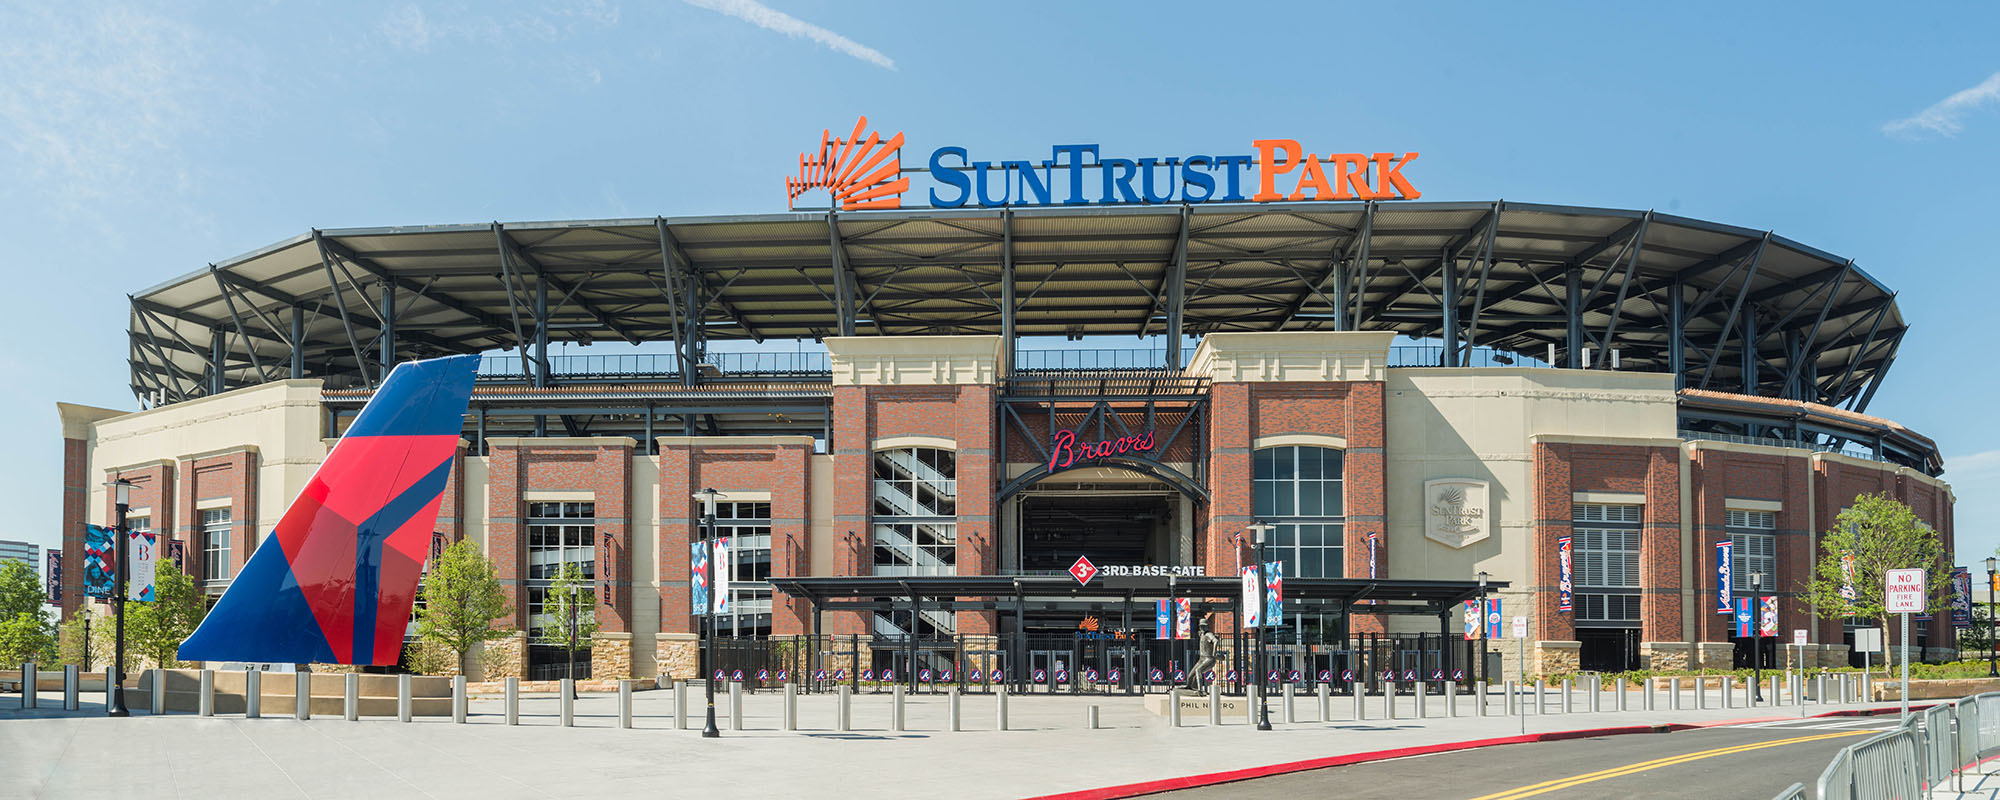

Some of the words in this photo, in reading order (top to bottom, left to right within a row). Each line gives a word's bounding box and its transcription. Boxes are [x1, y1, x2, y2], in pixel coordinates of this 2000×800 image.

[1048, 429, 1154, 474] Braves
[1446, 515, 1473, 526] PARK
[139, 544, 149, 561] B
[1102, 565, 1128, 576] 3RD
[1132, 565, 1168, 576] BASE
[1173, 565, 1205, 576] GATE
[1898, 574, 1912, 583] NO
[87, 584, 111, 595] DINE
[1248, 578, 1255, 592] B
[1889, 584, 1921, 593] PARKING
[1180, 702, 1199, 710] PHIL
